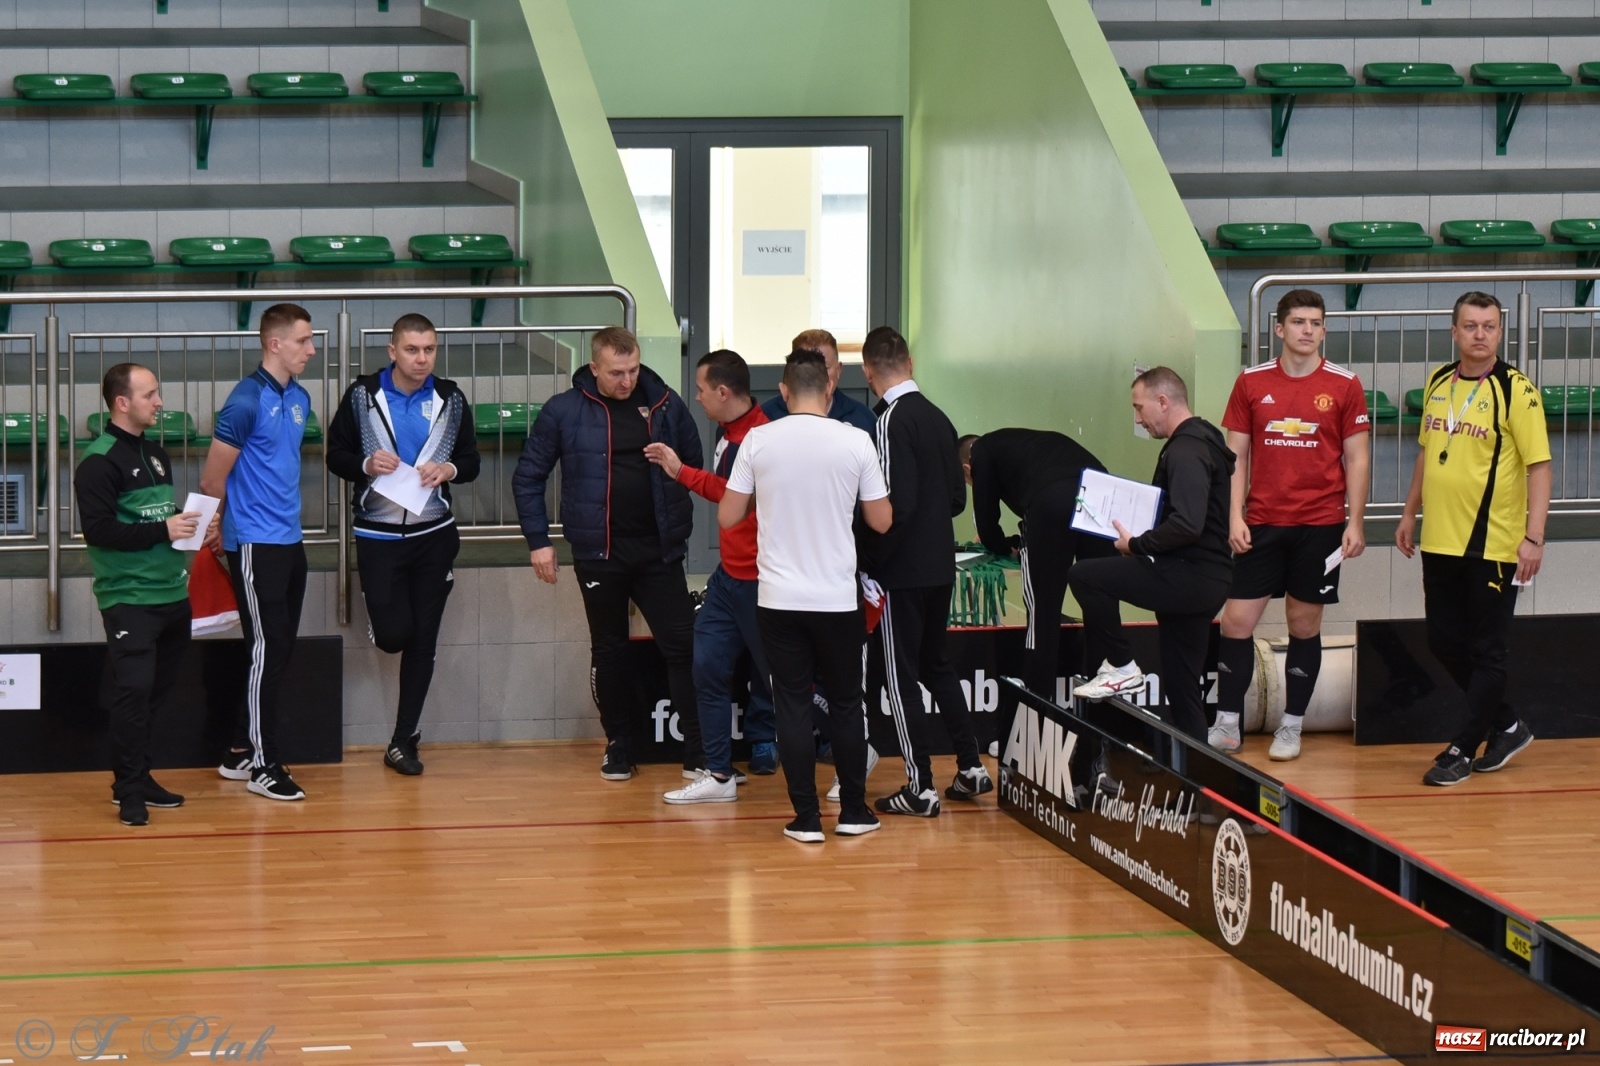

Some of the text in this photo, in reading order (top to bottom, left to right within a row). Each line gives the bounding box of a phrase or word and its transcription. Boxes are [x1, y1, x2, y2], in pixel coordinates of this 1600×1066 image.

[757, 245, 792, 254] WYJŚCIE
[1432, 417, 1489, 440] EVONIK
[1264, 438, 1319, 449] CHEVROLET
[9, 678, 15, 686] B
[1002, 701, 1077, 808] AMK
[1090, 834, 1190, 908] www.amkprofitechnic.cz
[1269, 880, 1434, 1023] florbalbohumin.cz
